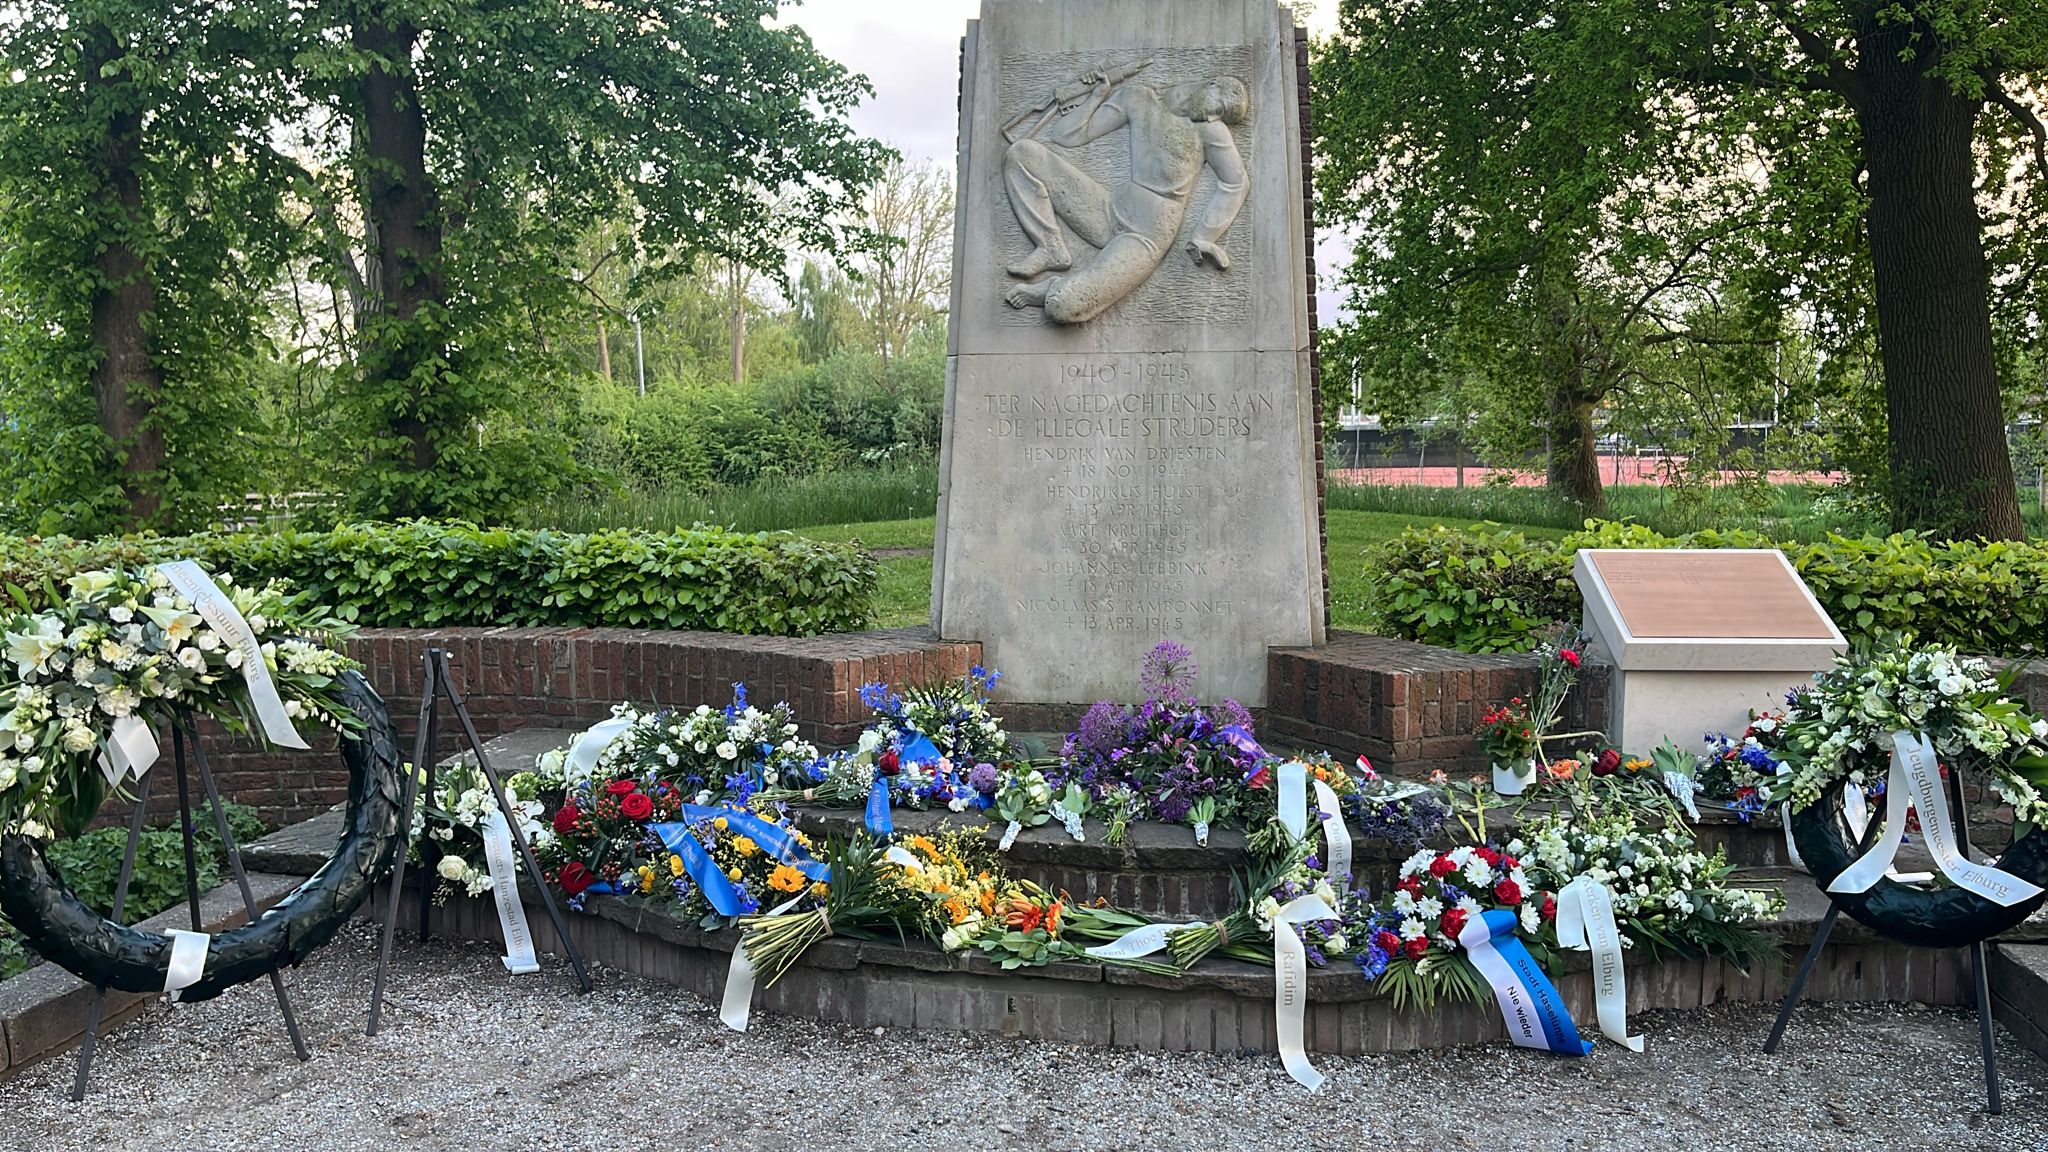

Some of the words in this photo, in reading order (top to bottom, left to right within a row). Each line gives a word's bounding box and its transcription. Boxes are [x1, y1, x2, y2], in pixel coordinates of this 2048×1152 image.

[983, 394, 1020, 414] TER
[1031, 392, 1217, 414] NAGEDACHTENIS
[1230, 391, 1273, 413] AAN
[998, 418, 1024, 438] DE
[1035, 418, 1131, 438] ILLEGALE
[1024, 447, 1095, 460] HENDRIK
[1104, 447, 1136, 460] VAN
[1147, 446, 1226, 460] DRIESTEN
[1082, 465, 1096, 478] 18
[1047, 485, 1142, 499] HENDRIKUS
[1152, 485, 1204, 499] HULST
[1145, 503, 1184, 517] 1945
[1058, 523, 1098, 537] AART
[1108, 523, 1191, 537] KRUITHOF
[1080, 541, 1101, 554] 30
[1149, 541, 1187, 555] 1945
[1040, 561, 1129, 575] JOHANNES
[1139, 561, 1208, 575] LEBBINK
[1145, 580, 1184, 593] 1945
[1017, 599, 1098, 613] NICOLAAS
[1125, 600, 1233, 614] RAMBONNET
[1084, 616, 1097, 630] 13
[1145, 616, 1184, 630] 1945
[1906, 747, 1961, 873] Jeugdburgemeester
[1961, 869, 2009, 899] Elburg
[499, 874, 519, 926] Hanzestad
[1583, 878, 1602, 921] Kerken
[1596, 924, 1608, 949] van
[1517, 958, 1540, 989] Stadt
[1601, 952, 1616, 997] Elburg
[1507, 984, 1519, 1006] Nie
[1515, 1006, 1533, 1040] wieder
